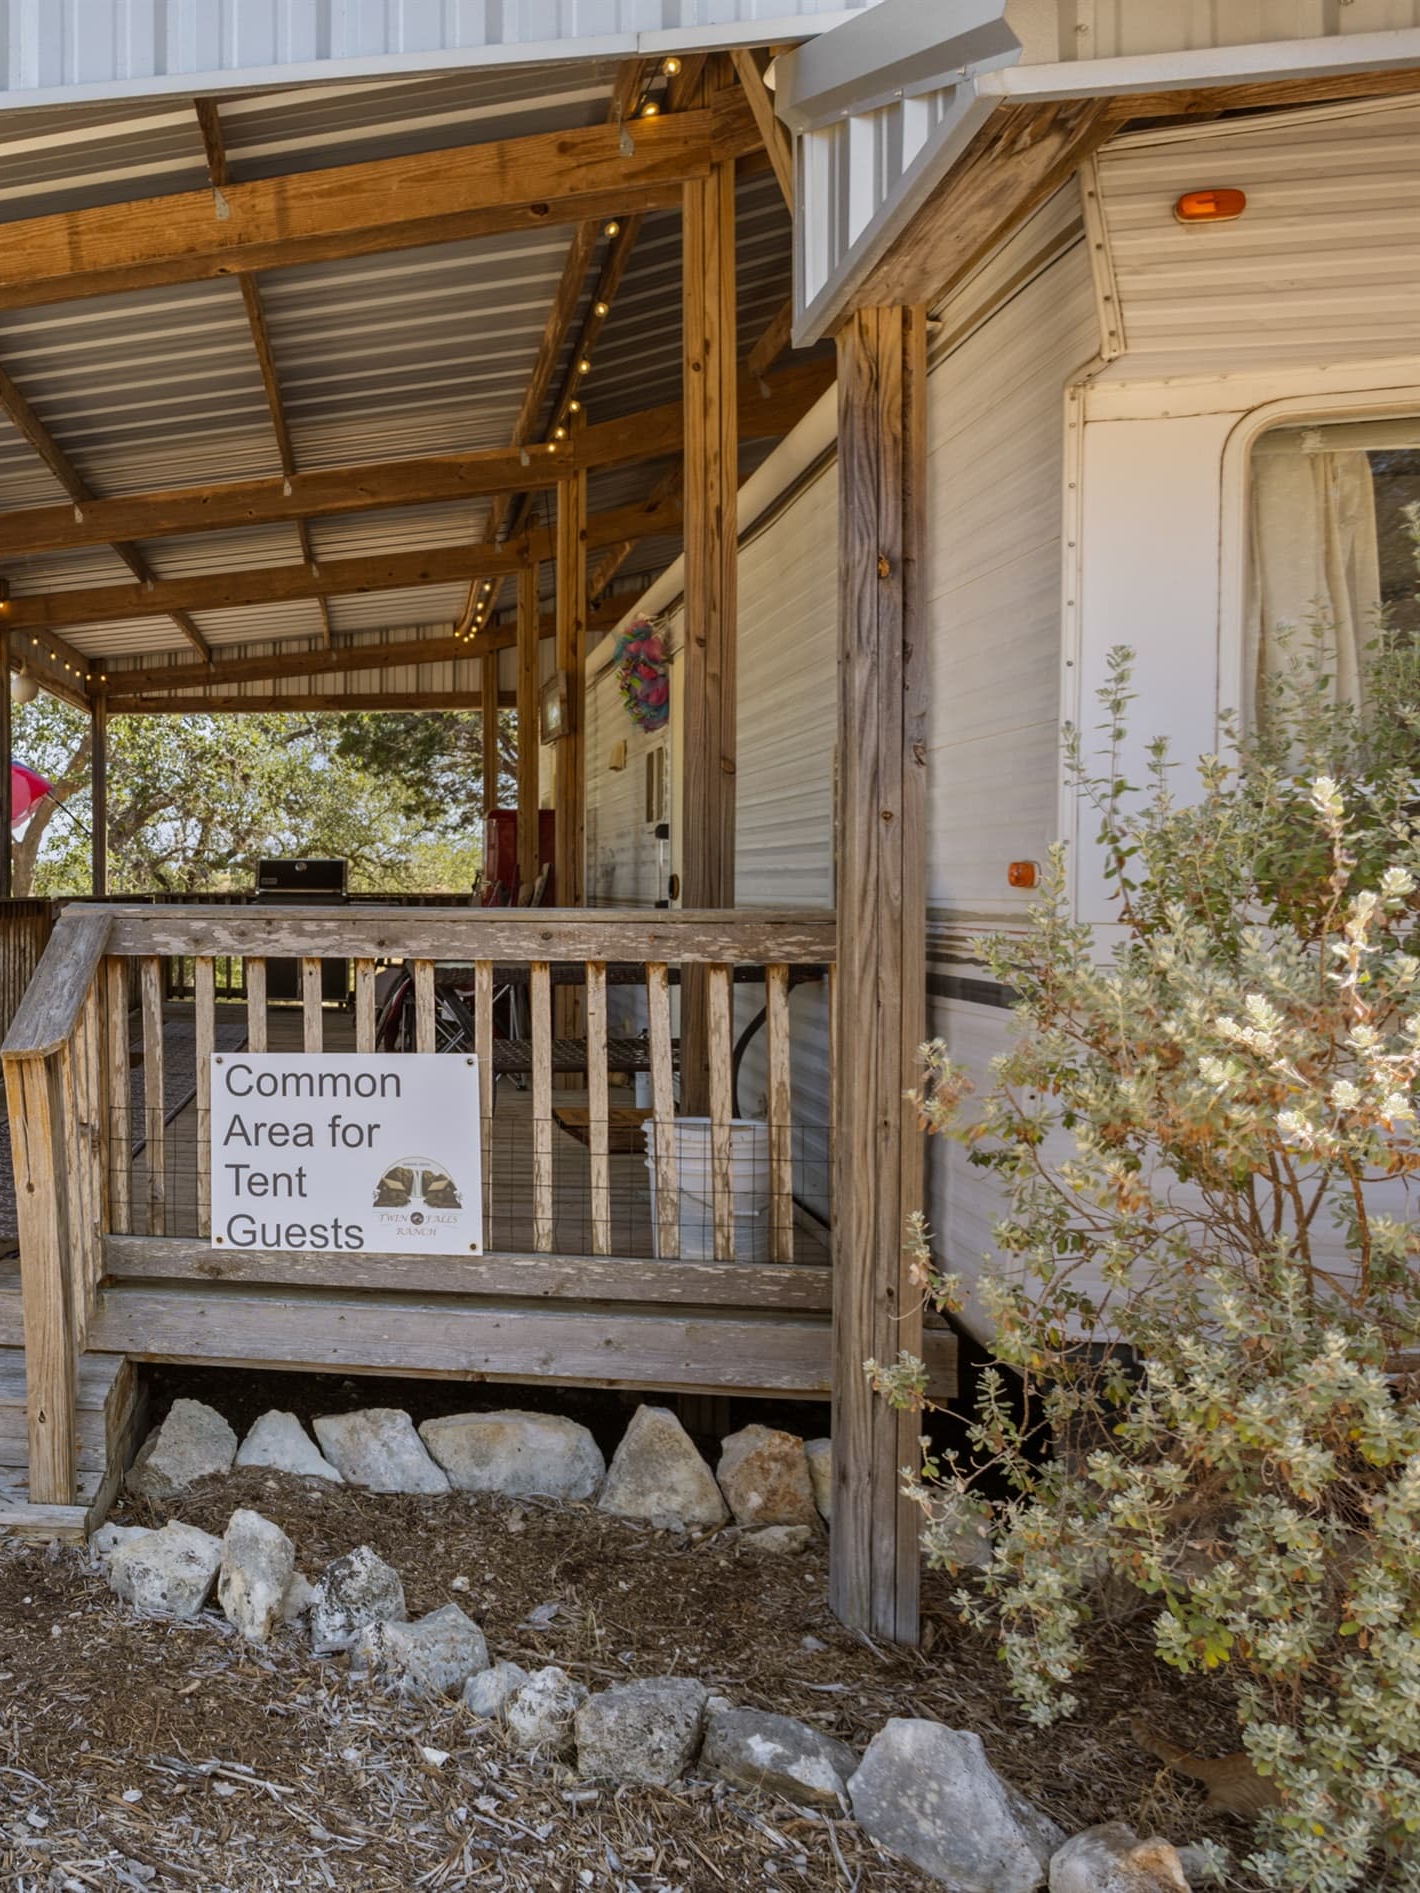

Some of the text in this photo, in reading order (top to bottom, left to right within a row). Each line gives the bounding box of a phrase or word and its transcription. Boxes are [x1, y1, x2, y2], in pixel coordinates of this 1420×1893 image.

[225, 1063, 401, 1098] Common
[223, 1114, 381, 1148] Area for
[225, 1164, 308, 1198] Tent
[226, 1213, 365, 1250] Guests
